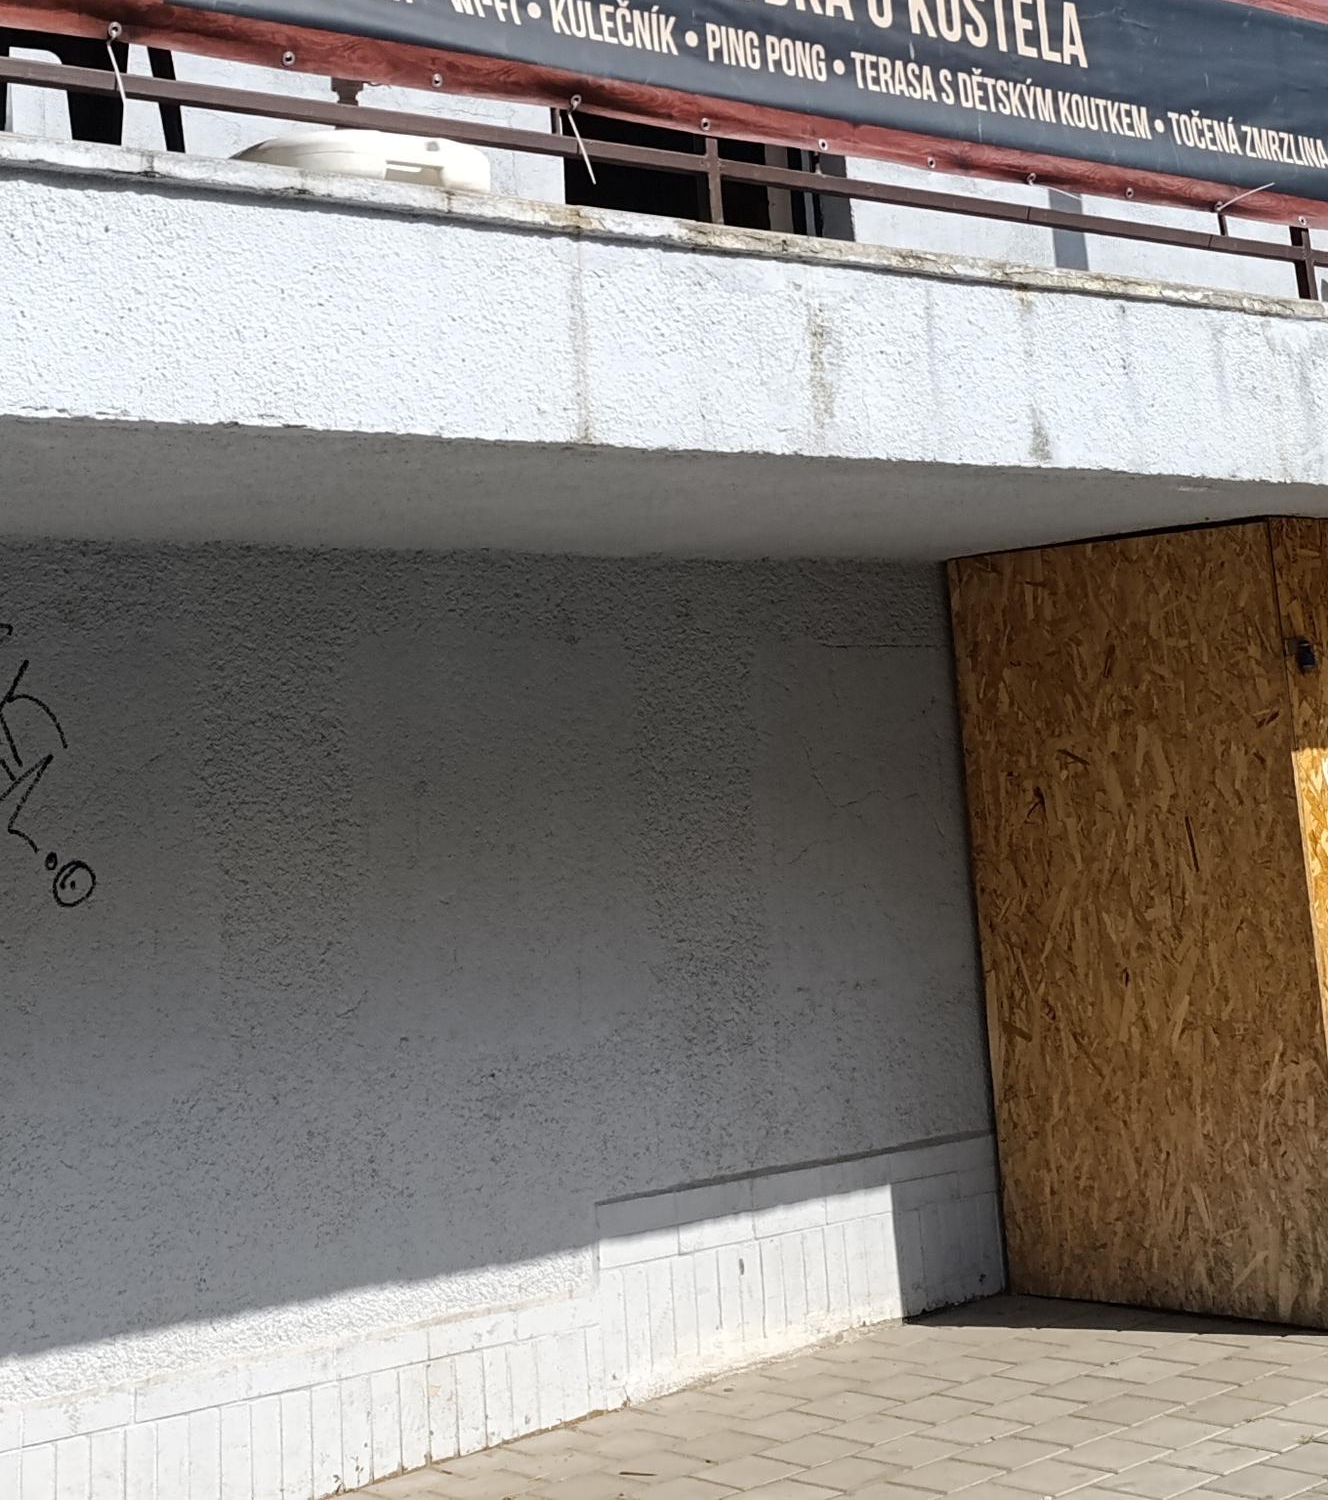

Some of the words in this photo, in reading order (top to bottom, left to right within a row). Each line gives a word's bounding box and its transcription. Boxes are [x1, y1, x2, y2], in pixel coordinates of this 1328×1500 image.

[706, 22, 761, 71] PING
[766, 35, 828, 83] PONG
[850, 50, 939, 103] TERASA
[939, 67, 955, 106] S
[957, 67, 1057, 124] DĚTSKÝM
[1056, 90, 1153, 140] KOUTKEM
[1167, 108, 1244, 156] TOČENÁ
